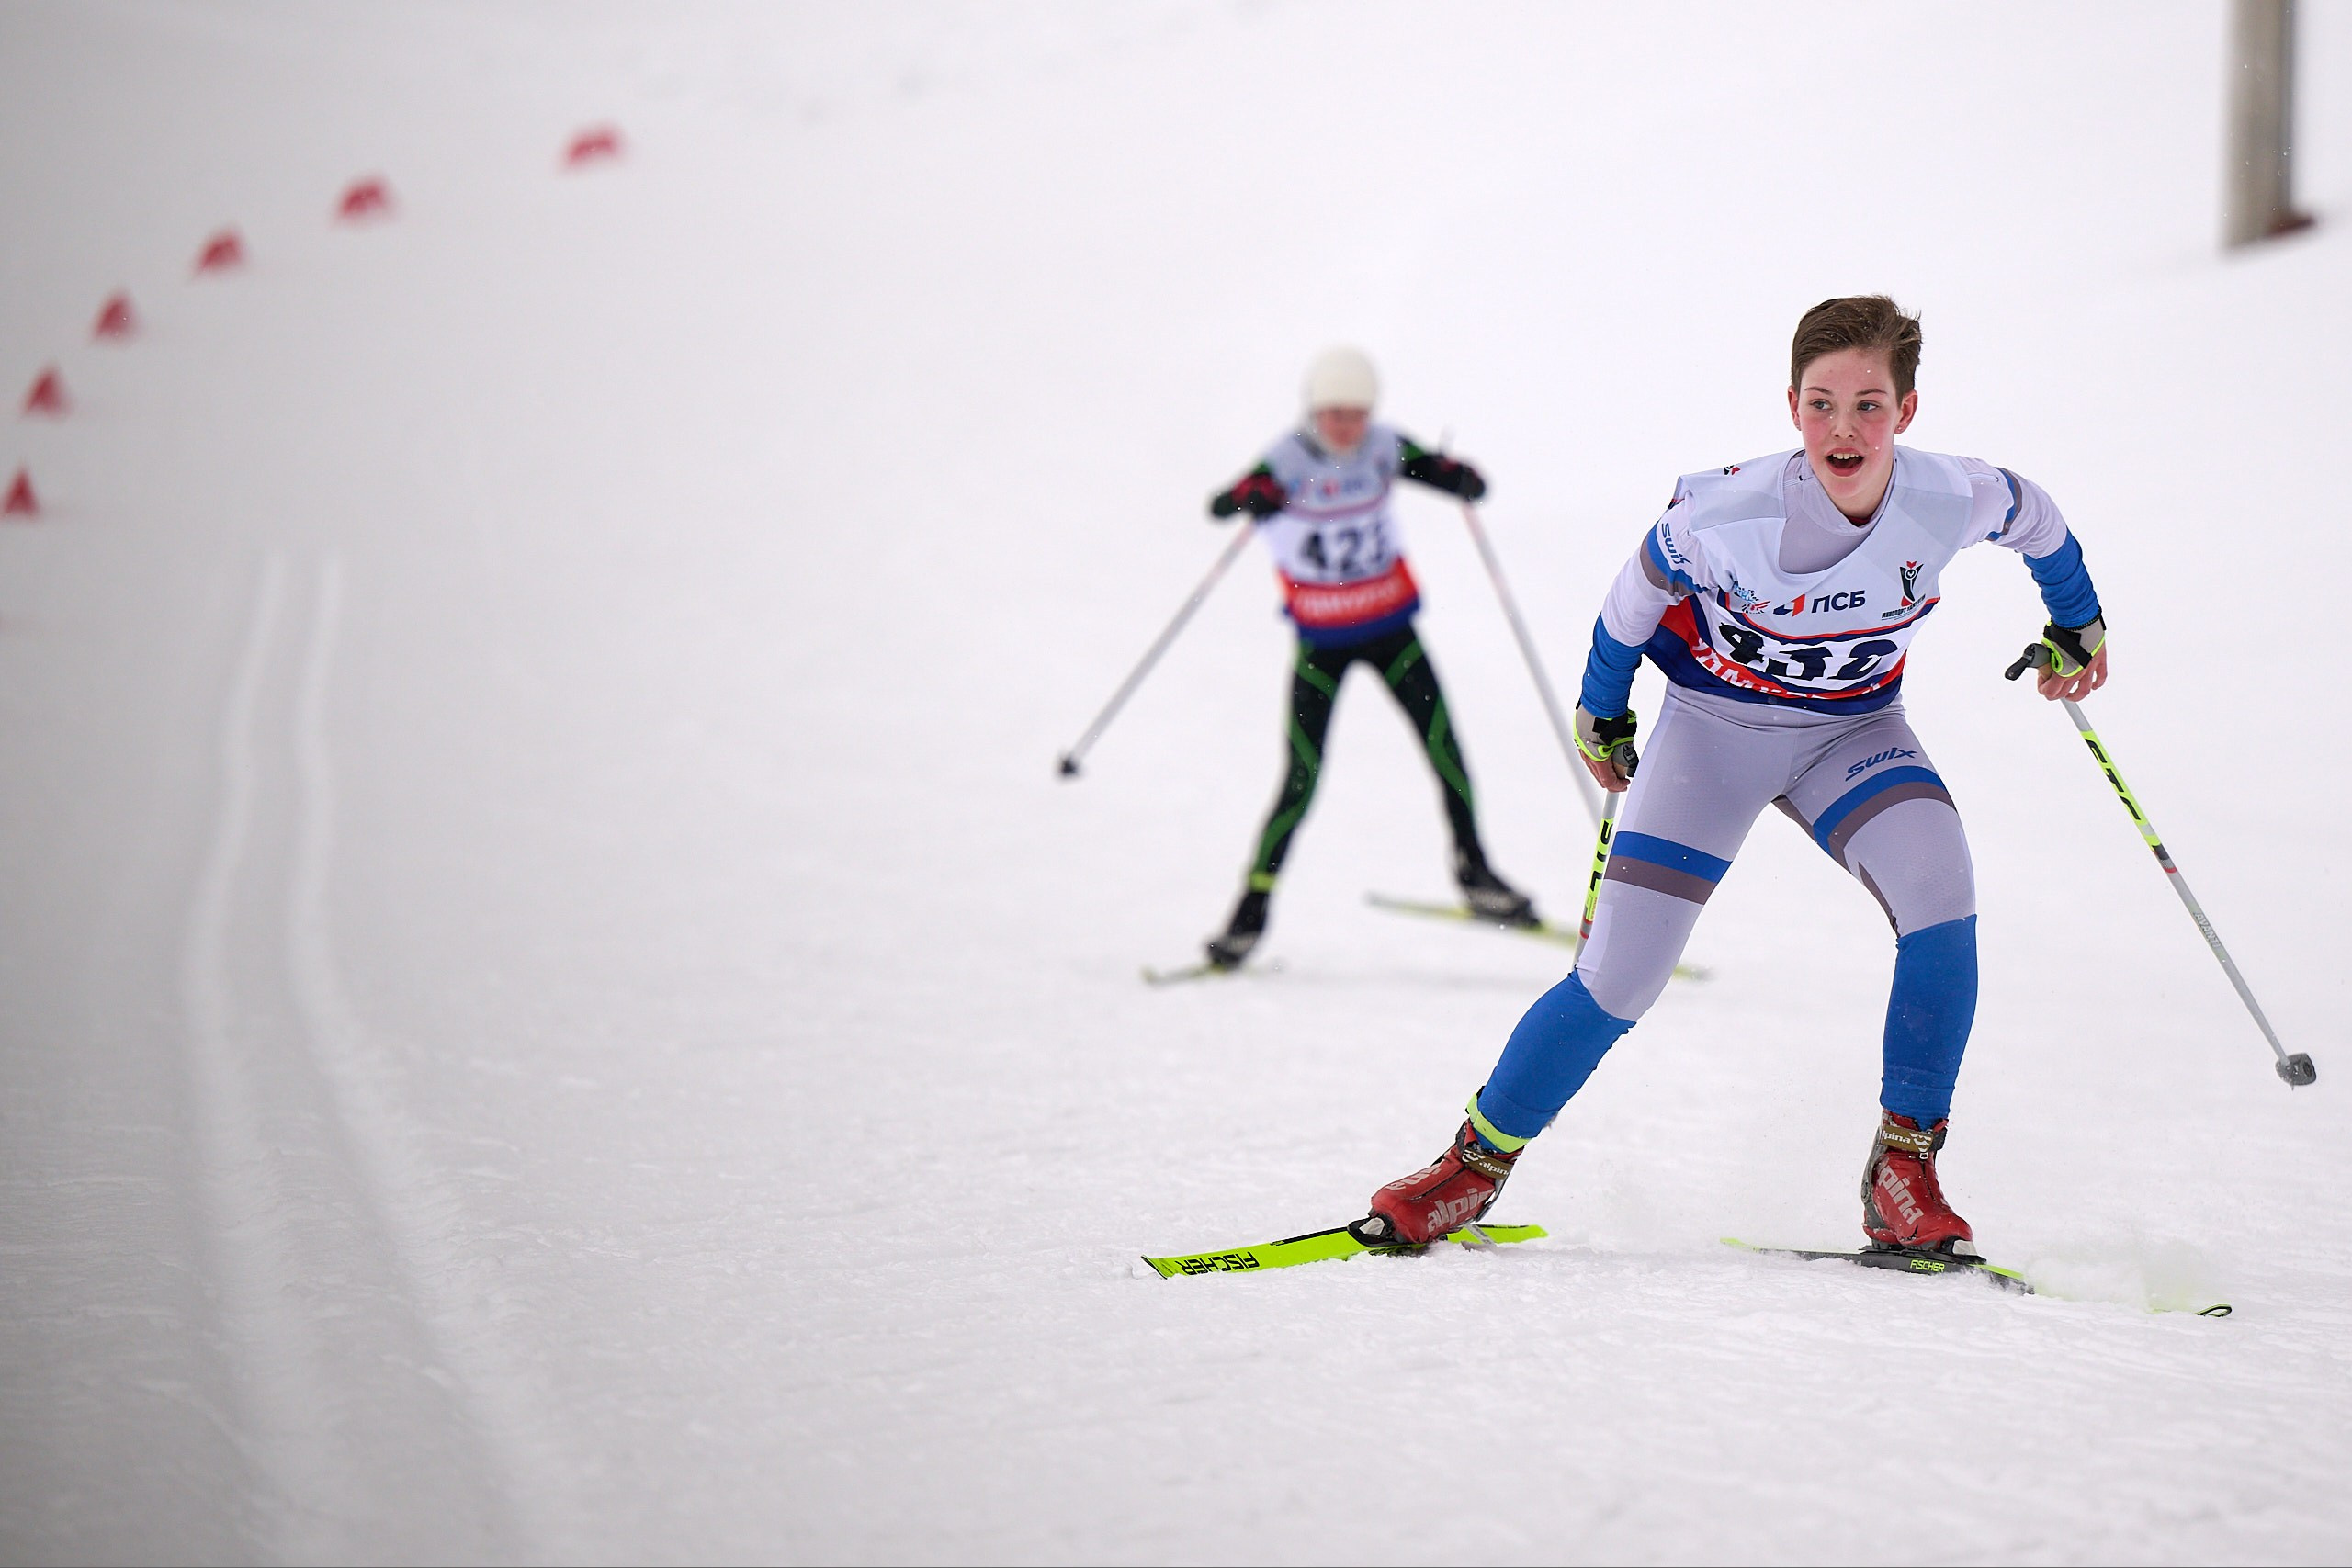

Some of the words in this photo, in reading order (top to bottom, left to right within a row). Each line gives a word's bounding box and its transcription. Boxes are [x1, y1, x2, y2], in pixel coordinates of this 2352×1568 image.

[1811, 590, 1866, 614] ПСБ
[2192, 911, 2222, 948] AVANTI
[1479, 1161, 1509, 1176] alpin
[1174, 1251, 1260, 1276] FISCHER
[1910, 1259, 1945, 1273] FISCHER
